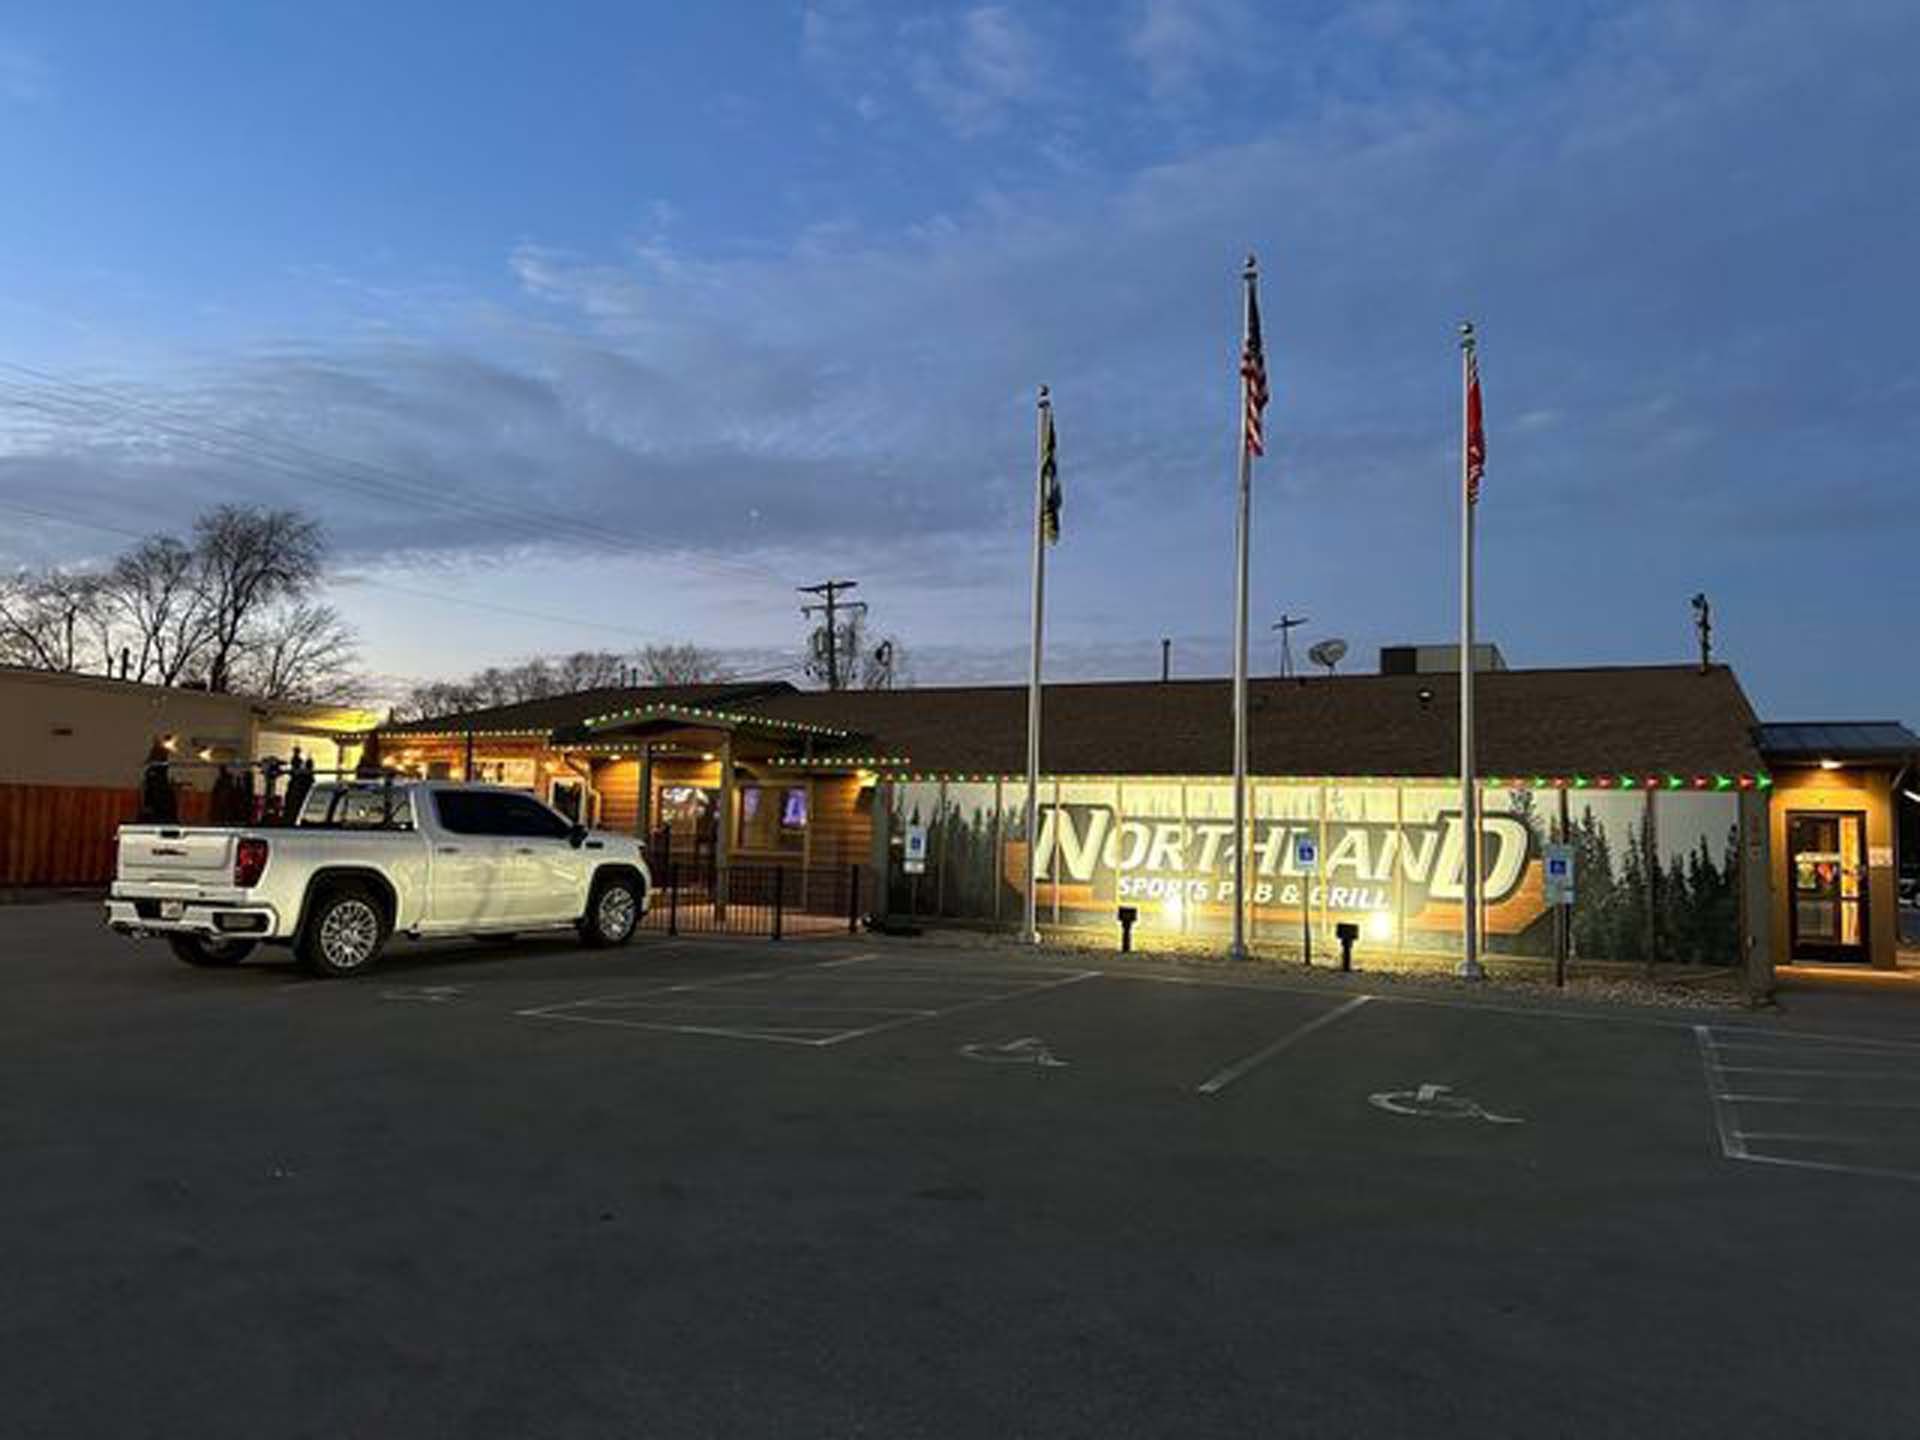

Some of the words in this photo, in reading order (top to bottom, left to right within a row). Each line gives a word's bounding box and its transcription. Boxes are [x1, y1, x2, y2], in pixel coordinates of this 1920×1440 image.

[1034, 807, 1529, 898] NORTHLAND
[1118, 876, 1209, 901] SPORTS
[1280, 883, 1300, 904] &
